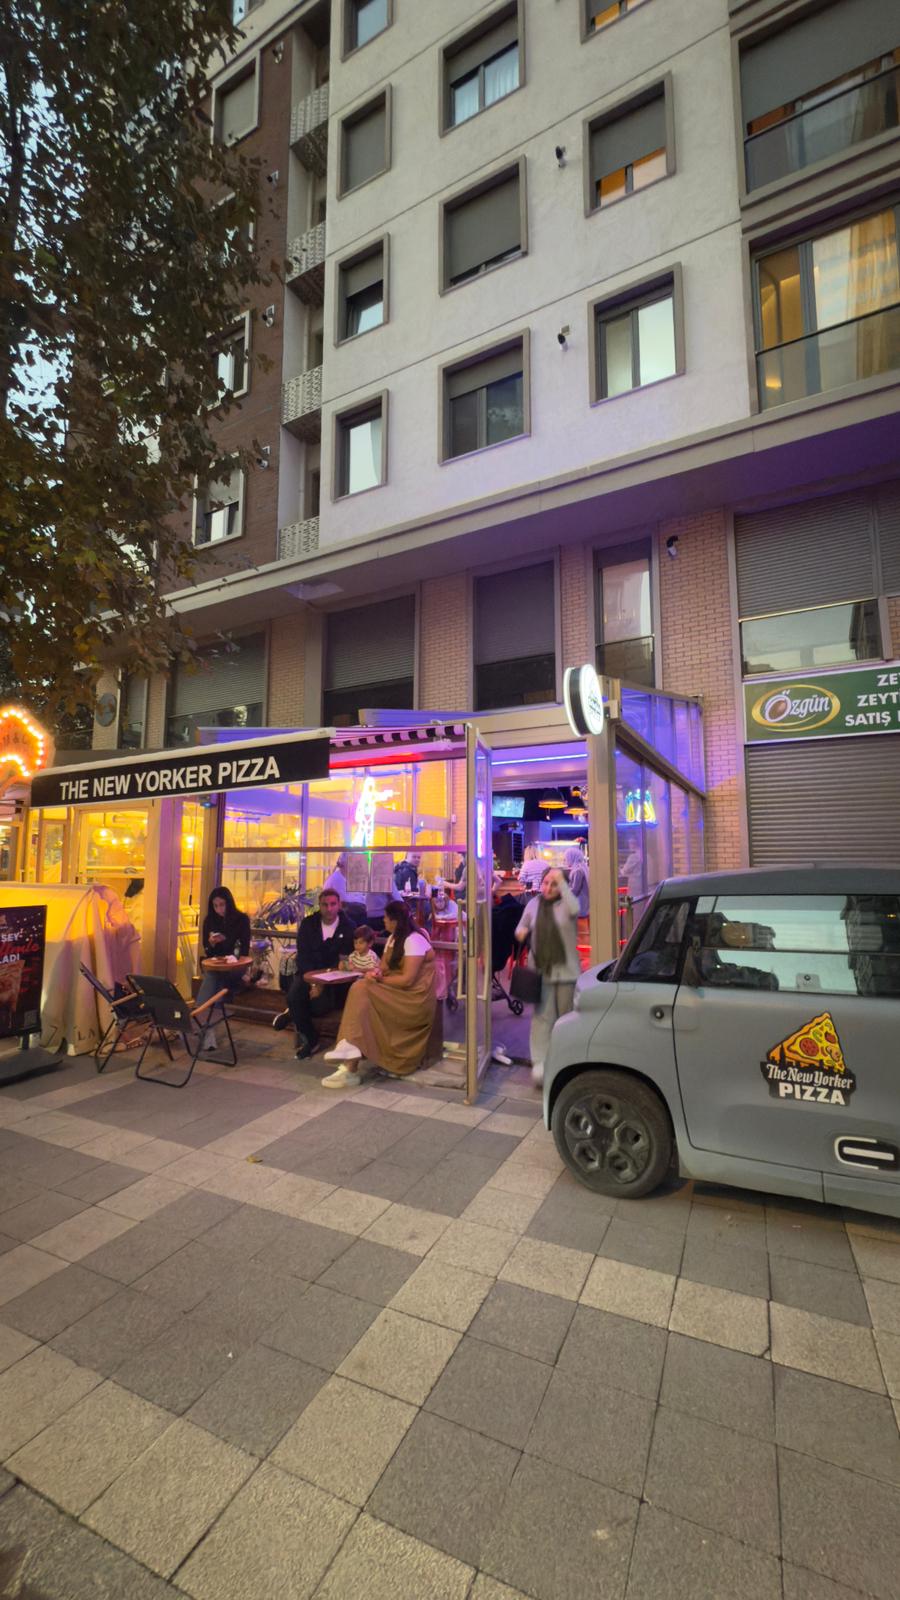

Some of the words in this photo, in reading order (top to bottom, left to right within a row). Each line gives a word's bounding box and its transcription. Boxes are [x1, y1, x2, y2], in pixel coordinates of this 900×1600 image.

[765, 689, 830, 722] Özgün
[857, 689, 900, 707] ZEYT
[845, 711, 891, 727] SATIŞ
[59, 779, 89, 801] THE
[93, 774, 132, 798] NEW
[135, 765, 212, 793] YORKER
[218, 756, 280, 784] PIZZA
[766, 1063, 787, 1081] The
[787, 1066, 814, 1082] New
[814, 1070, 854, 1089] Yorker
[779, 1082, 846, 1106] PIZZA
